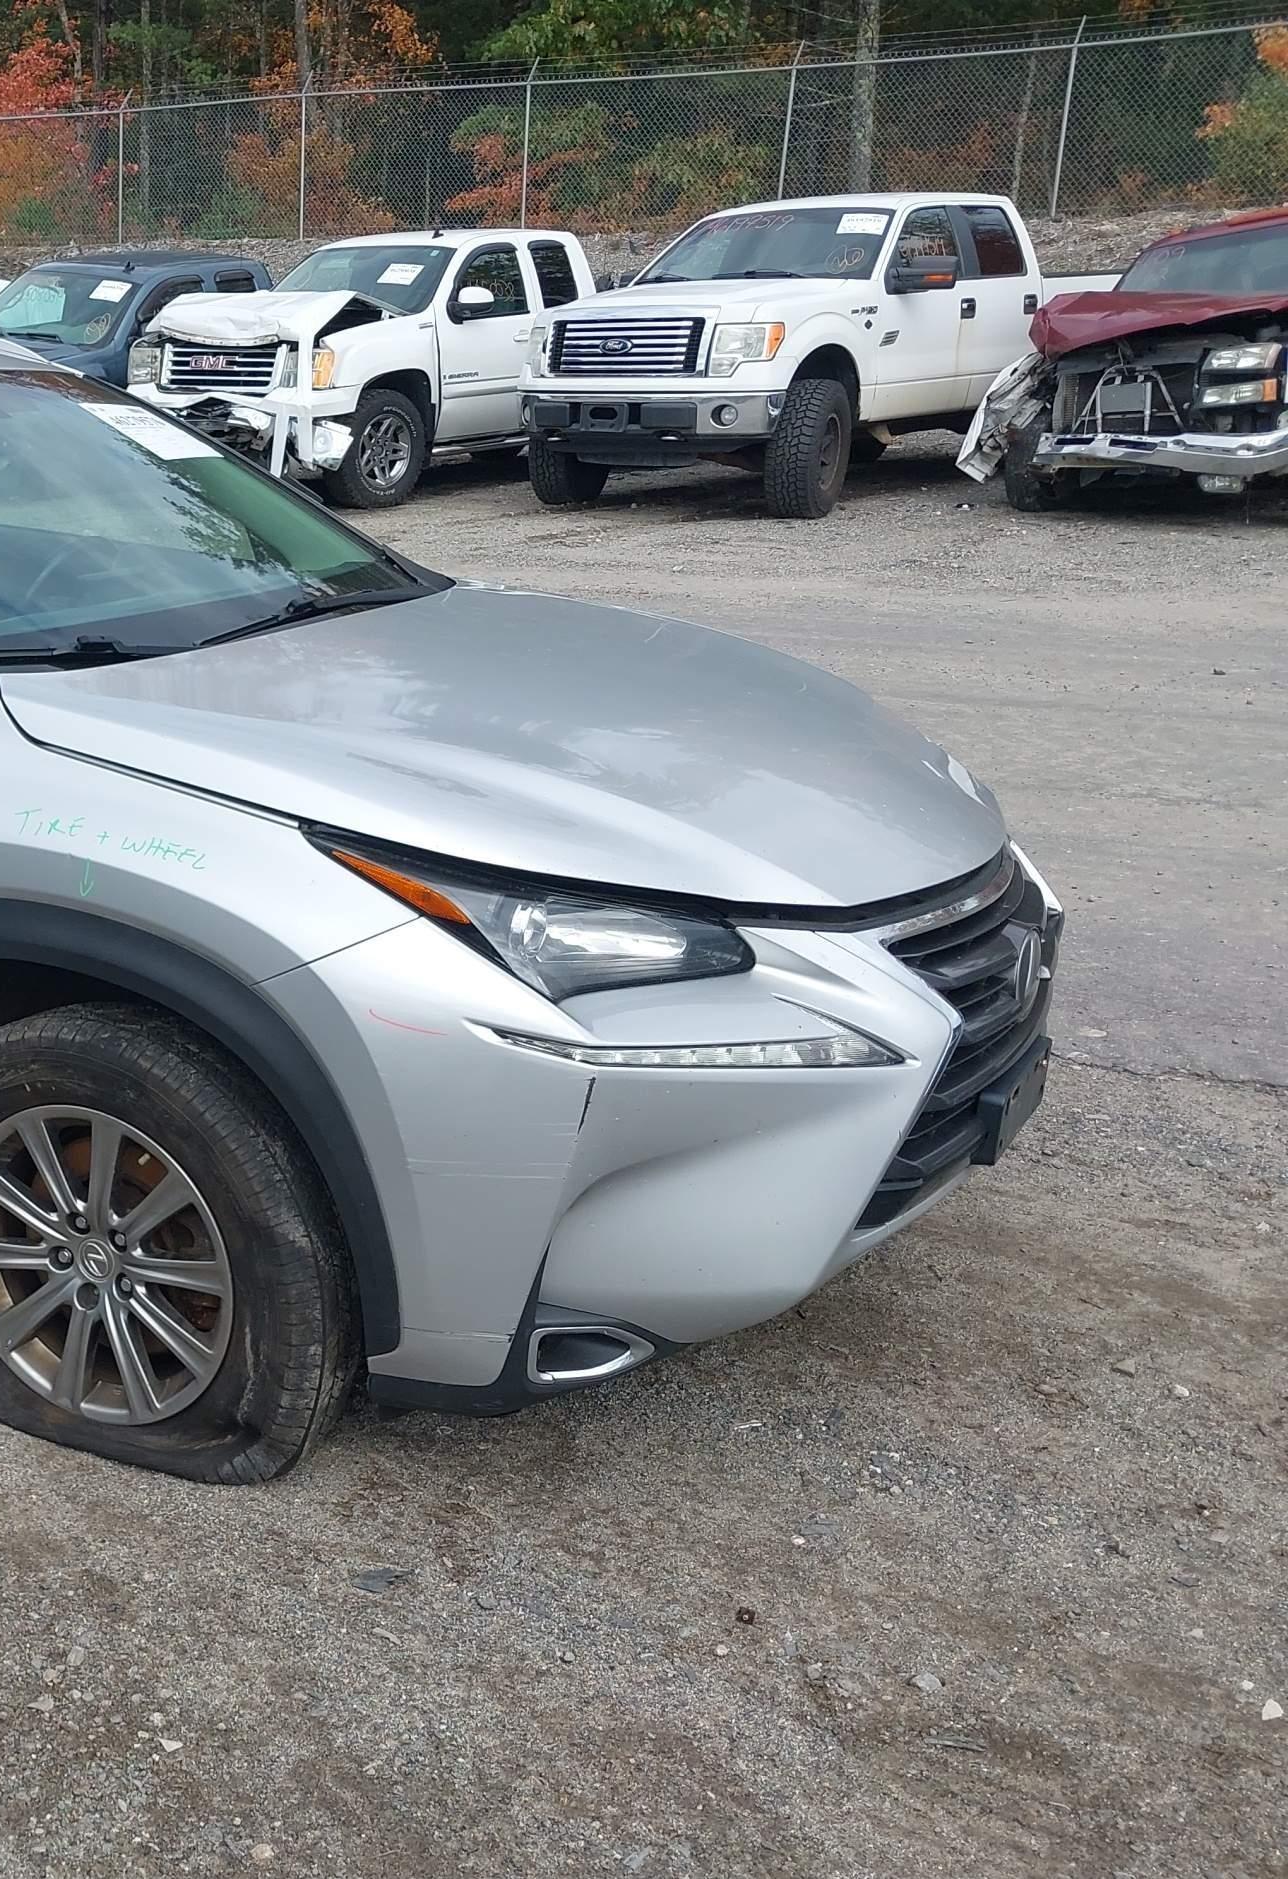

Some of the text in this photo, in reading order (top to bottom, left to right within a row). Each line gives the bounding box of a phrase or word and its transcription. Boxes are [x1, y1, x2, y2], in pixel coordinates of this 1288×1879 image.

[190, 355, 239, 370] GMC
[15, 808, 86, 836] TIRE
[120, 835, 207, 871] WHEEL
